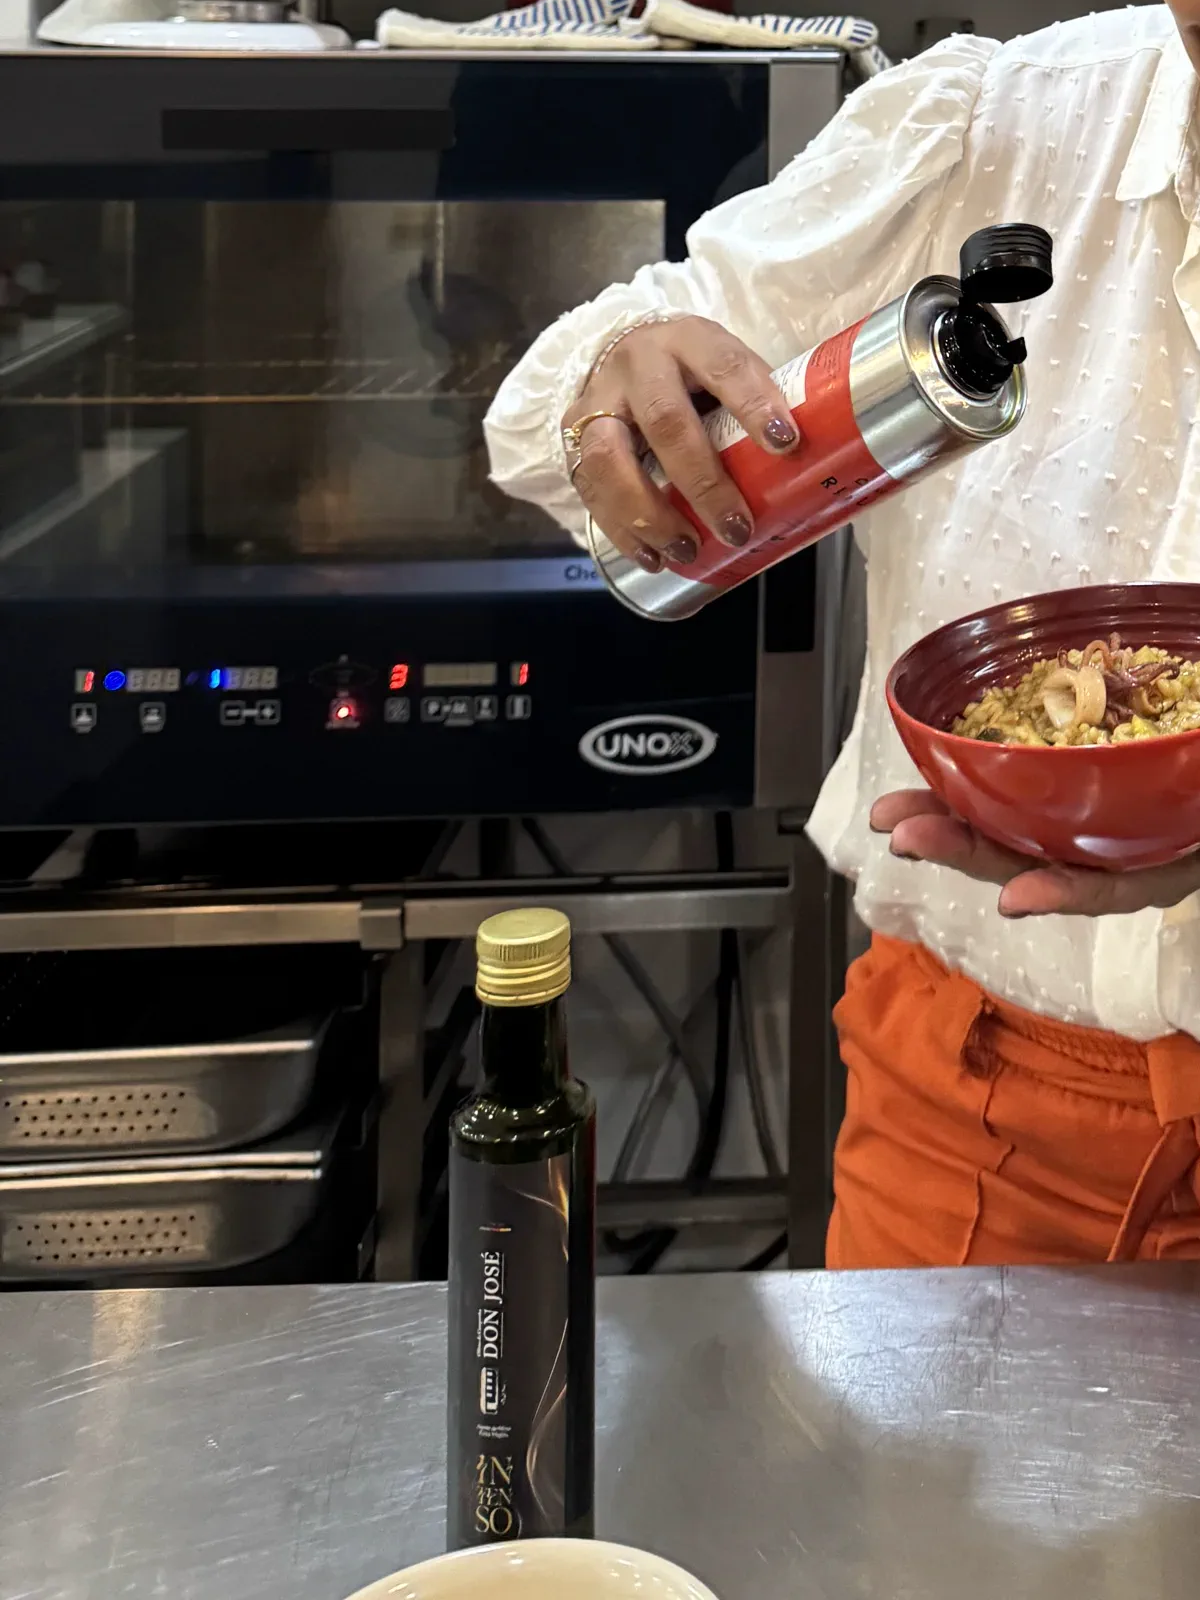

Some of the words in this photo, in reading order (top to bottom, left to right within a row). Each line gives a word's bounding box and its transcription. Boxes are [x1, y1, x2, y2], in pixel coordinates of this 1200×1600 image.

[596, 731, 695, 758] UNOX
[480, 1251, 502, 1304] JOSÉ
[483, 1308, 499, 1359] DON
[475, 1505, 513, 1535] SO
